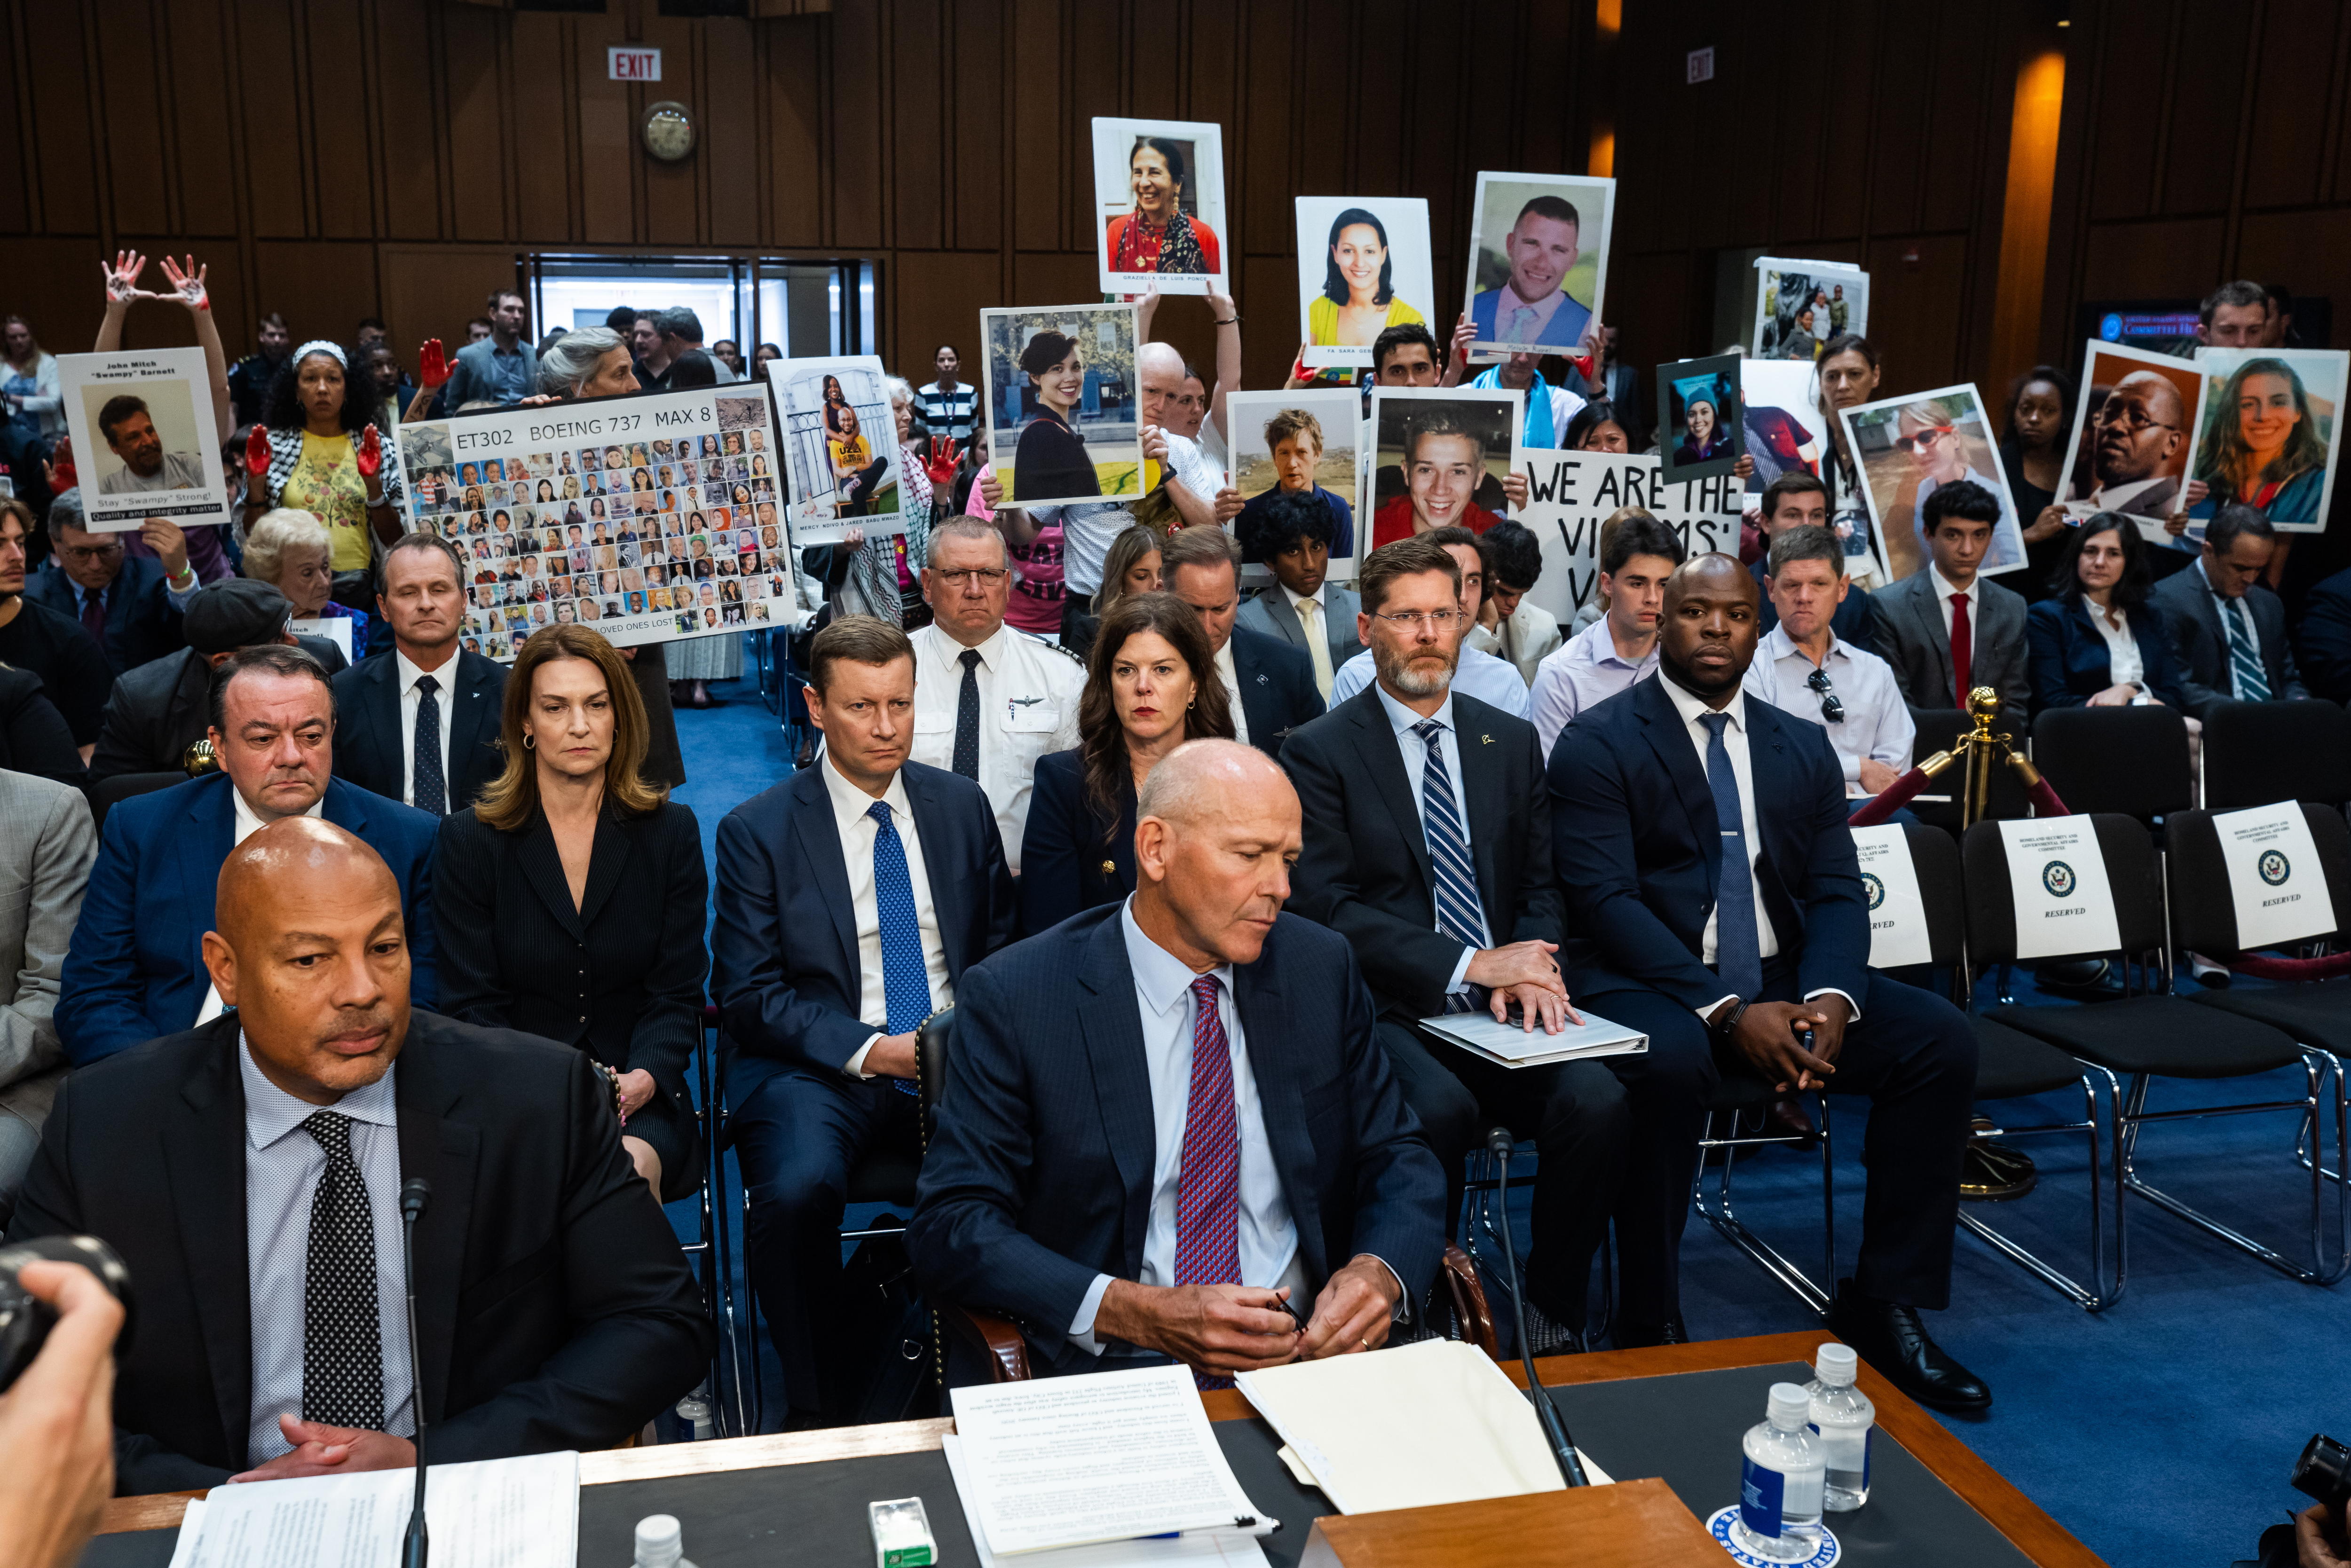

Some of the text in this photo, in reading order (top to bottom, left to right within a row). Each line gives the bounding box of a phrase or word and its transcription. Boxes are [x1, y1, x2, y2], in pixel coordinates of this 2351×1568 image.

[616, 53, 654, 78] EXIT
[457, 407, 711, 449] ET302 BOEING 737 MAX 8
[1526, 461, 1582, 505] WE
[1593, 465, 1666, 510] ARE
[124, 495, 173, 505] "Swampy"
[176, 492, 211, 503] Strong!
[93, 511, 126, 520] Quality
[149, 506, 188, 517] integrity
[190, 504, 221, 513] matter
[626, 622, 649, 630] ONES
[652, 618, 673, 628] LOST
[2237, 831, 2271, 840] GOVERNMENTAL
[2253, 835, 2278, 843] COMMITTEE
[2263, 894, 2301, 907] RESERVED
[2045, 907, 2086, 918] RESERVED
[1870, 920, 1894, 930] RVED
